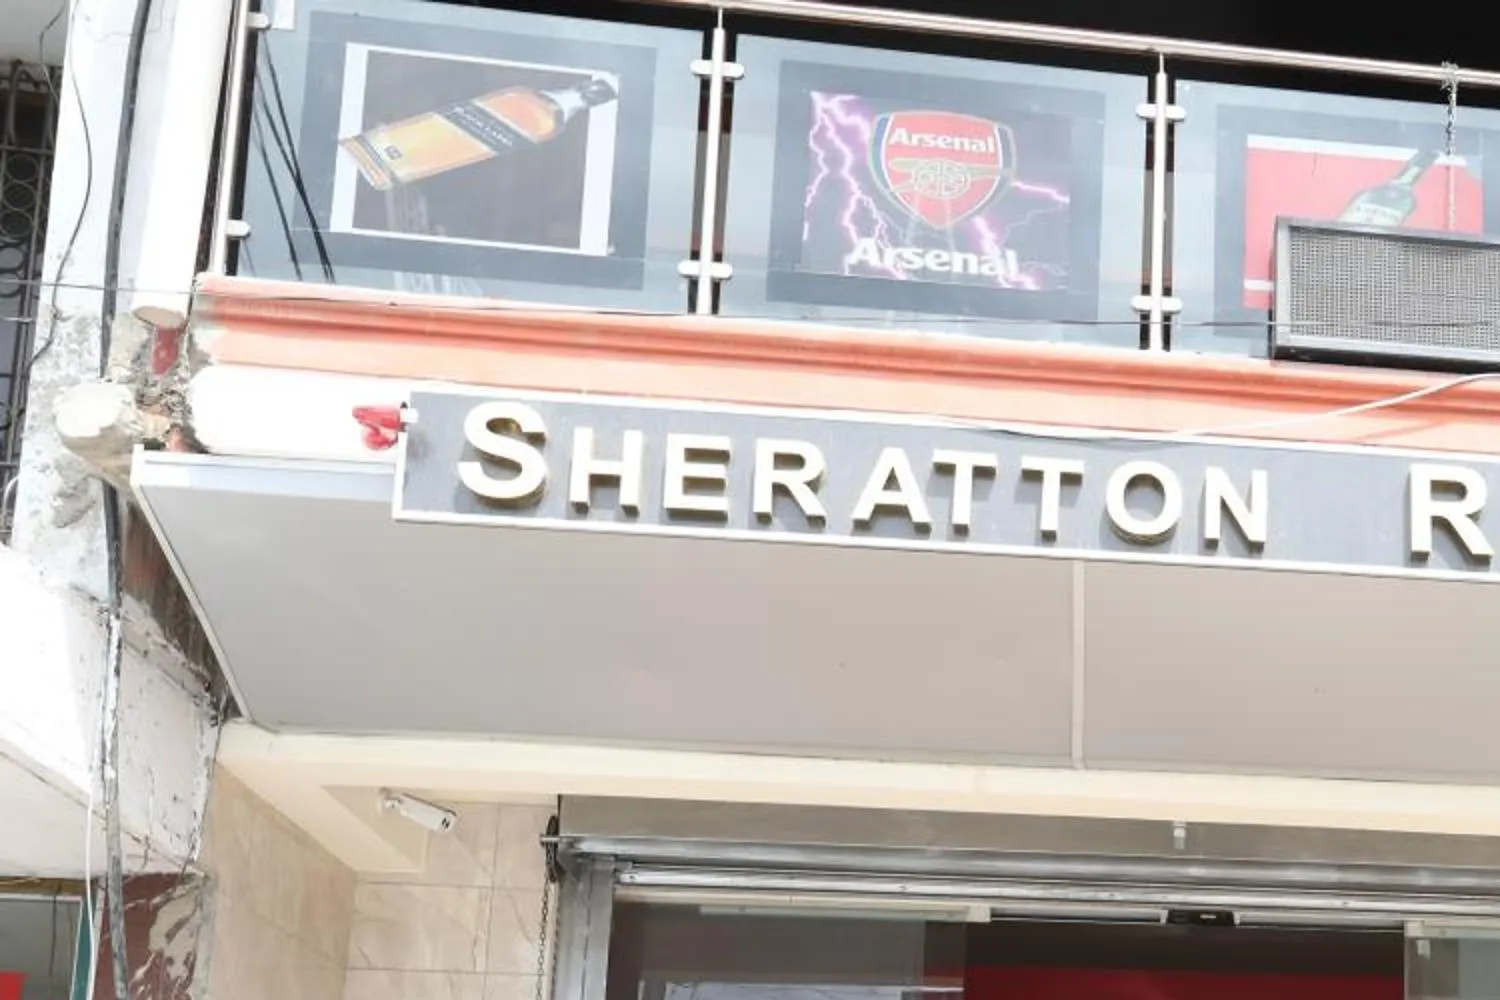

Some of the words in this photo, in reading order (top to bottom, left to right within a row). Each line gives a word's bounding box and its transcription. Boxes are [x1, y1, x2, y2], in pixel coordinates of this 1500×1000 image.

[888, 127, 996, 154] Arsenal
[846, 236, 1019, 277] Arsenal
[456, 401, 1268, 552] SHERATTON
